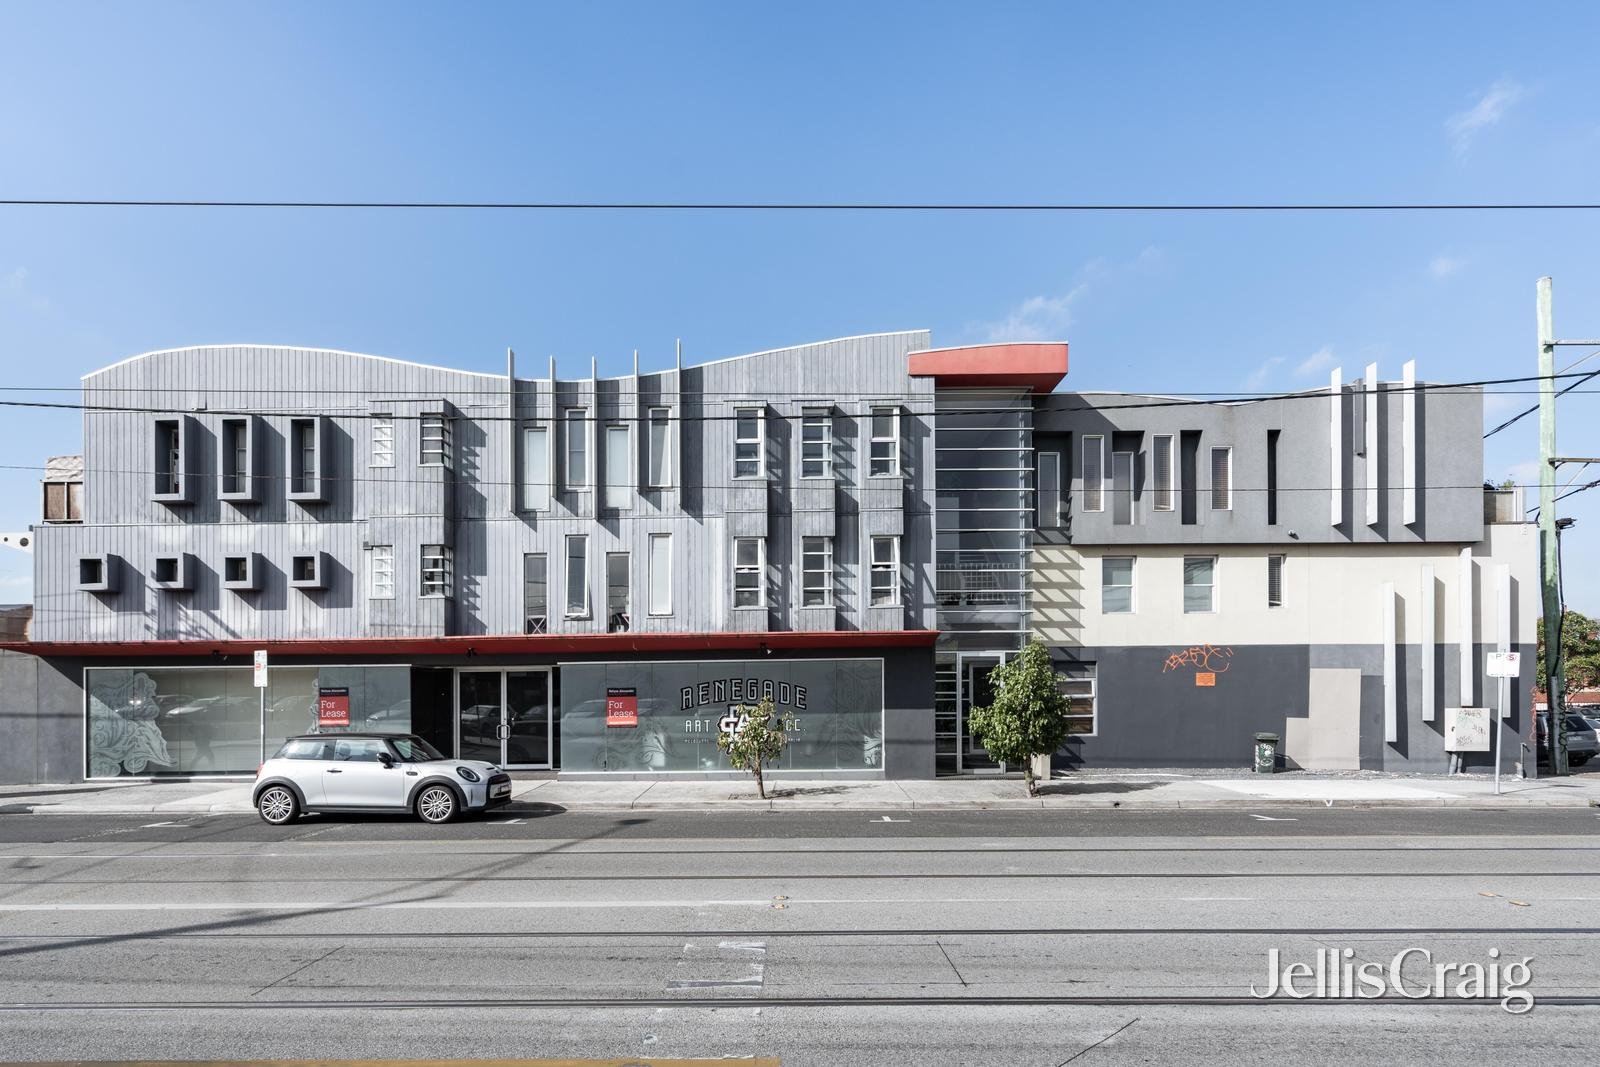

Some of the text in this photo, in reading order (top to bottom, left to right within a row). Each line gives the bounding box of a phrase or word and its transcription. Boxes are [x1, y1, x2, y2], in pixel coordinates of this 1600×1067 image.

[681, 678, 807, 710] RENEGADE
[320, 700, 336, 709] For
[608, 700, 624, 709] For
[320, 709, 346, 718] Lease
[608, 709, 634, 718] Lease
[685, 719, 711, 733] ART
